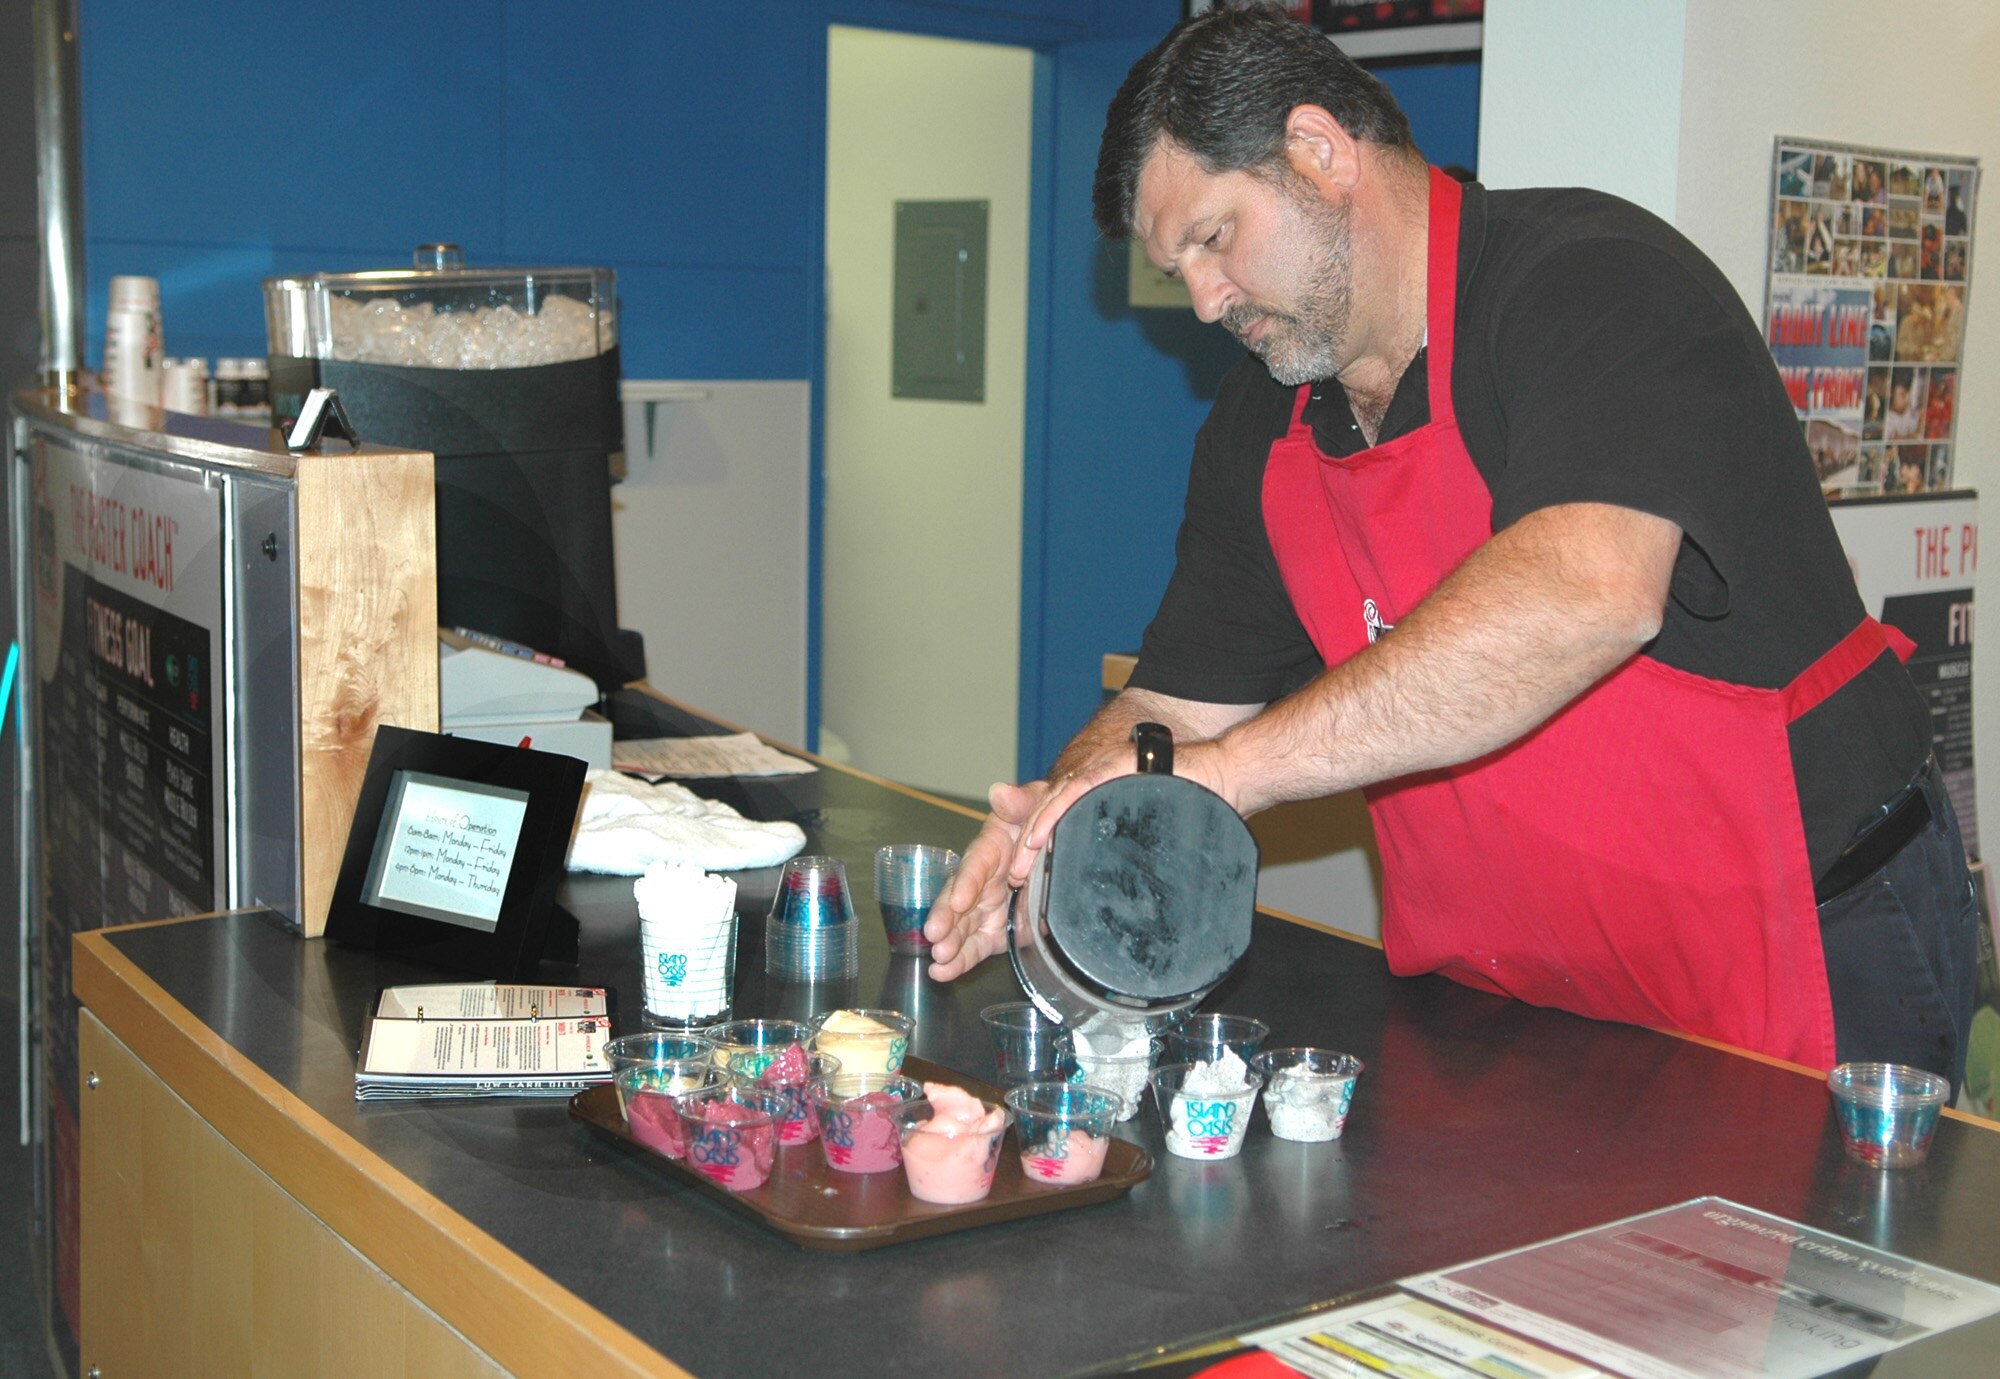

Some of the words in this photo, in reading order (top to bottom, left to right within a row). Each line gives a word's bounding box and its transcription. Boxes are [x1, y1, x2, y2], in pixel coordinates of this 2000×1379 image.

[1769, 304, 1824, 346] FRONT
[1829, 304, 1868, 348] LINE
[1813, 366, 1865, 409] FRONT
[1915, 525, 1951, 580] THE
[87, 598, 123, 669] FITNESS
[125, 619, 155, 688] GOAL
[459, 815, 497, 835] Operation
[442, 831, 472, 850] Monday
[480, 838, 507, 859] Friday
[436, 848, 466, 869] Monday
[474, 856, 500, 876] Friday
[428, 865, 457, 886] Monday
[468, 874, 501, 897] Thursday
[658, 964, 687, 977] OASIS
[659, 953, 688, 965] ISLAND
[476, 1081, 501, 1090] LOW
[508, 1081, 542, 1089] CARB
[549, 1080, 585, 1088] DIETS
[1185, 1101, 1237, 1119] ISLAND
[1186, 1119, 1233, 1137] OASIS
